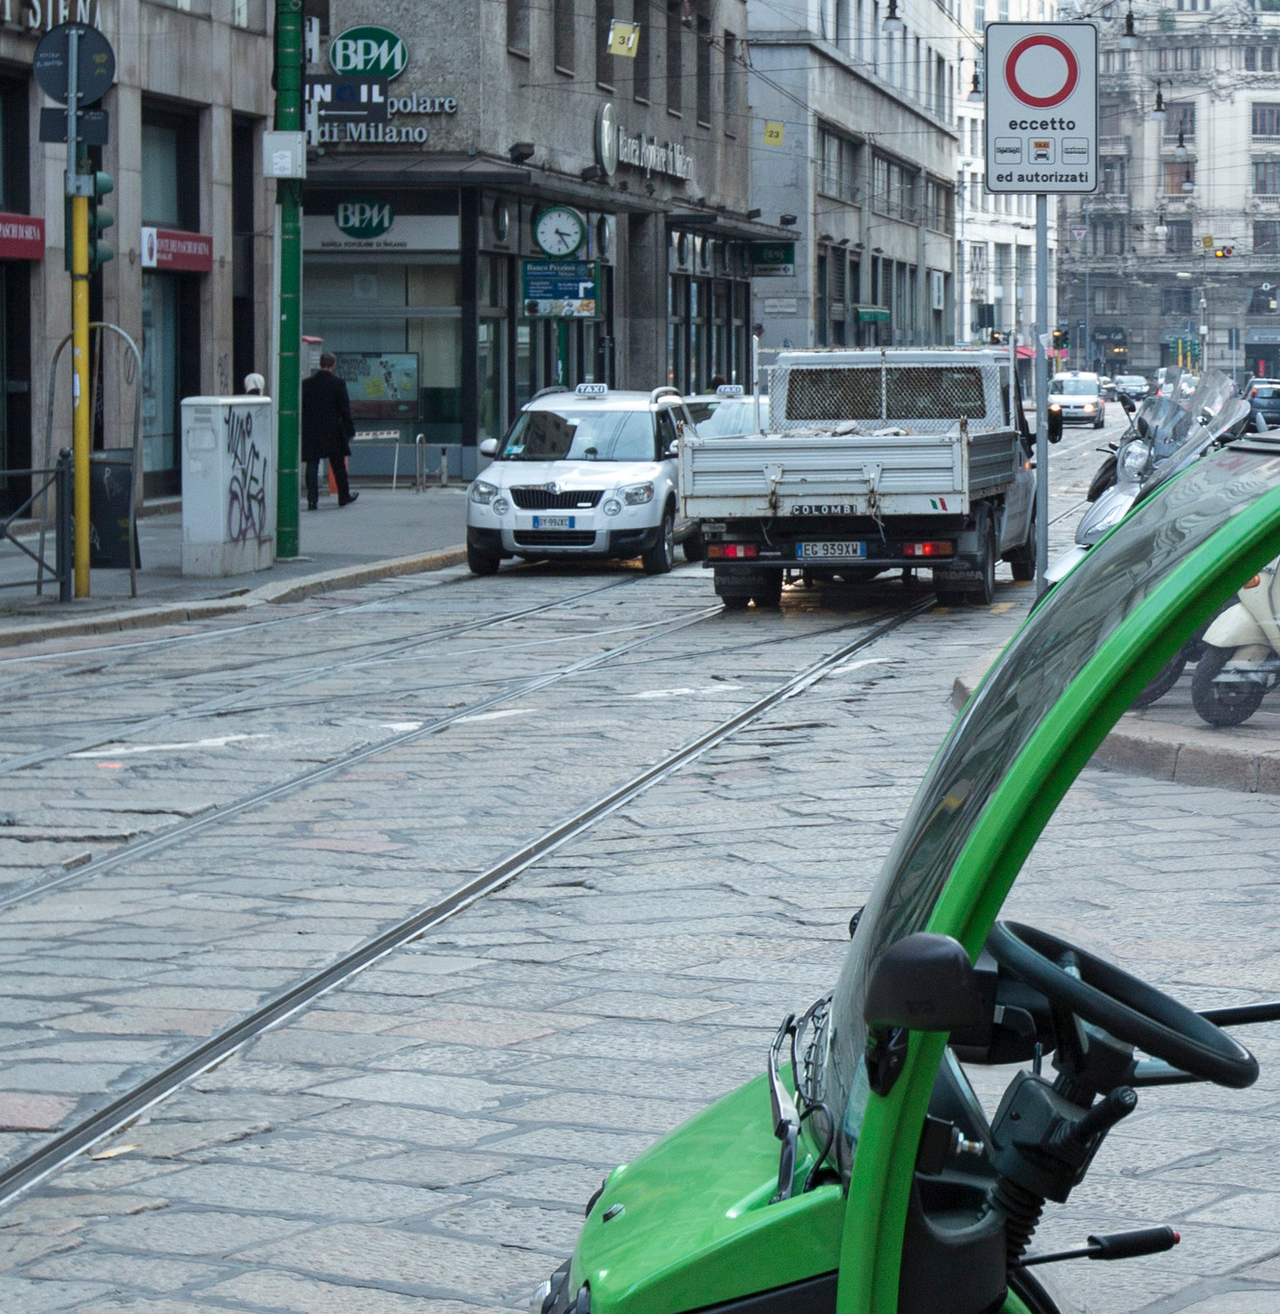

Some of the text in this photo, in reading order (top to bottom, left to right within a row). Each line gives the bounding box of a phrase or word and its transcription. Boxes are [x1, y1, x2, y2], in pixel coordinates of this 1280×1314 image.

[335, 39, 404, 71] BPM
[387, 92, 458, 119] polare
[1009, 118, 1076, 131] eccetto
[318, 122, 427, 144] di Milano
[768, 130, 780, 139] 23
[996, 171, 1088, 182] ed autorizzati
[338, 203, 390, 227] BPM
[793, 505, 856, 514] COLOMBI
[804, 544, 858, 555] EG 939XW
